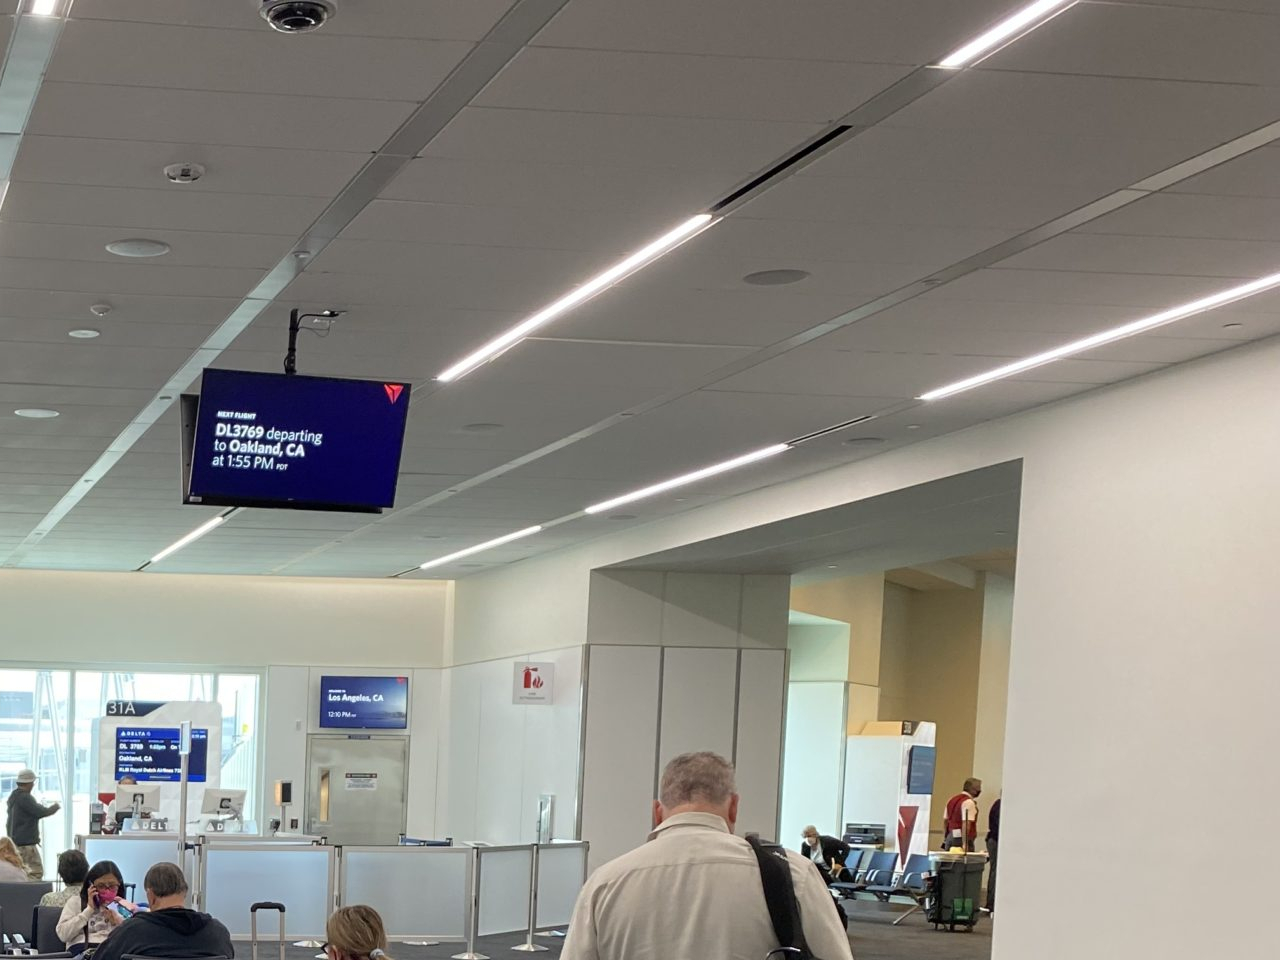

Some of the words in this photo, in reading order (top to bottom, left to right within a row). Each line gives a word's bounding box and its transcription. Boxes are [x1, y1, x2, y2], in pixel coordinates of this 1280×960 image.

[234, 412, 257, 420] FLIGHT
[215, 423, 265, 439] DL3769
[266, 427, 323, 446] departing
[214, 439, 227, 451] to
[229, 440, 284, 457] Oakland,
[286, 443, 305, 457] CA
[212, 456, 224, 467] at
[227, 455, 251, 468] 1:55
[254, 457, 274, 470] PM
[328, 693, 341, 702] Los
[372, 694, 385, 702] CA
[108, 701, 136, 715] 31A
[142, 820, 169, 831] DELT
